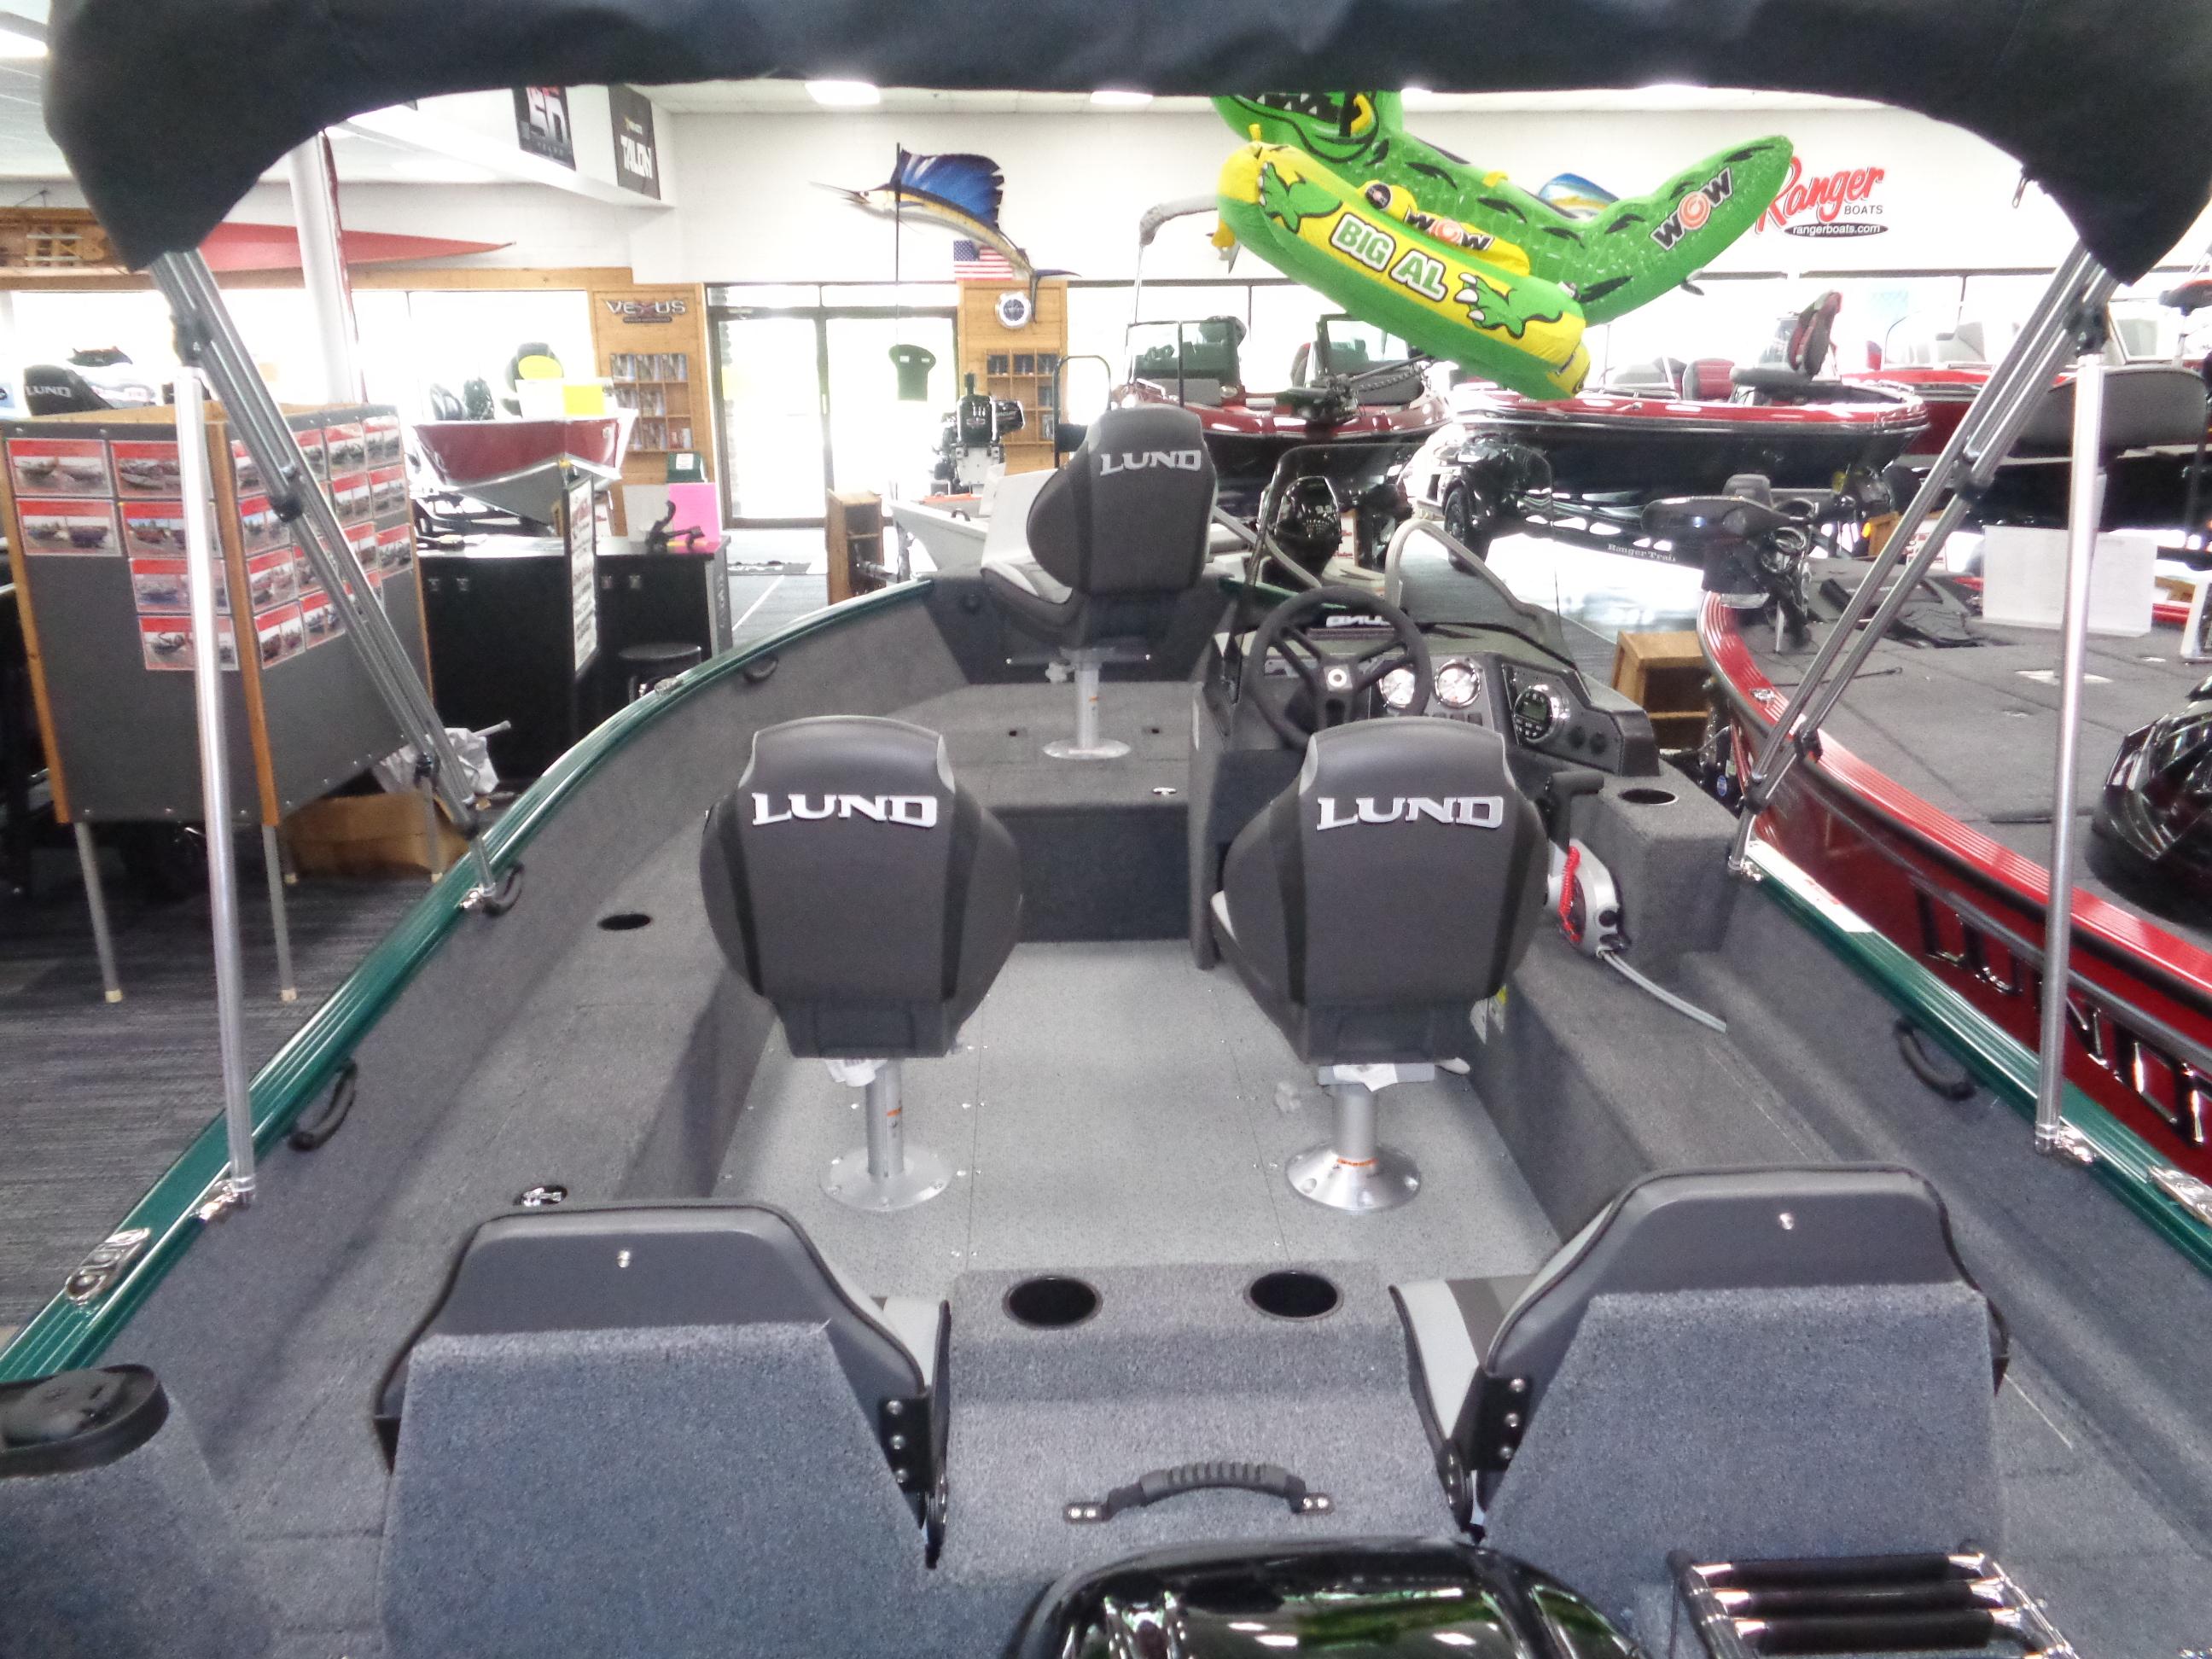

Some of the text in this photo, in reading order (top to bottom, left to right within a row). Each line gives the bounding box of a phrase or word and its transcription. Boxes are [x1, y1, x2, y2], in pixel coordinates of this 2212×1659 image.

[620, 135, 653, 179] TALON
[1650, 166, 1734, 250] WOW
[1755, 157, 1884, 233] Ranger
[1843, 205, 1883, 216] BOATS
[1404, 207, 1494, 251] WOW
[1792, 223, 1881, 236] rangerboats.com
[1333, 216, 1444, 299] BIG AL
[602, 298, 687, 317] VEXUS
[25, 385, 73, 399] LUND
[1099, 450, 1202, 476] LUND
[751, 792, 938, 828] LUND
[1316, 795, 1504, 831] LUND
